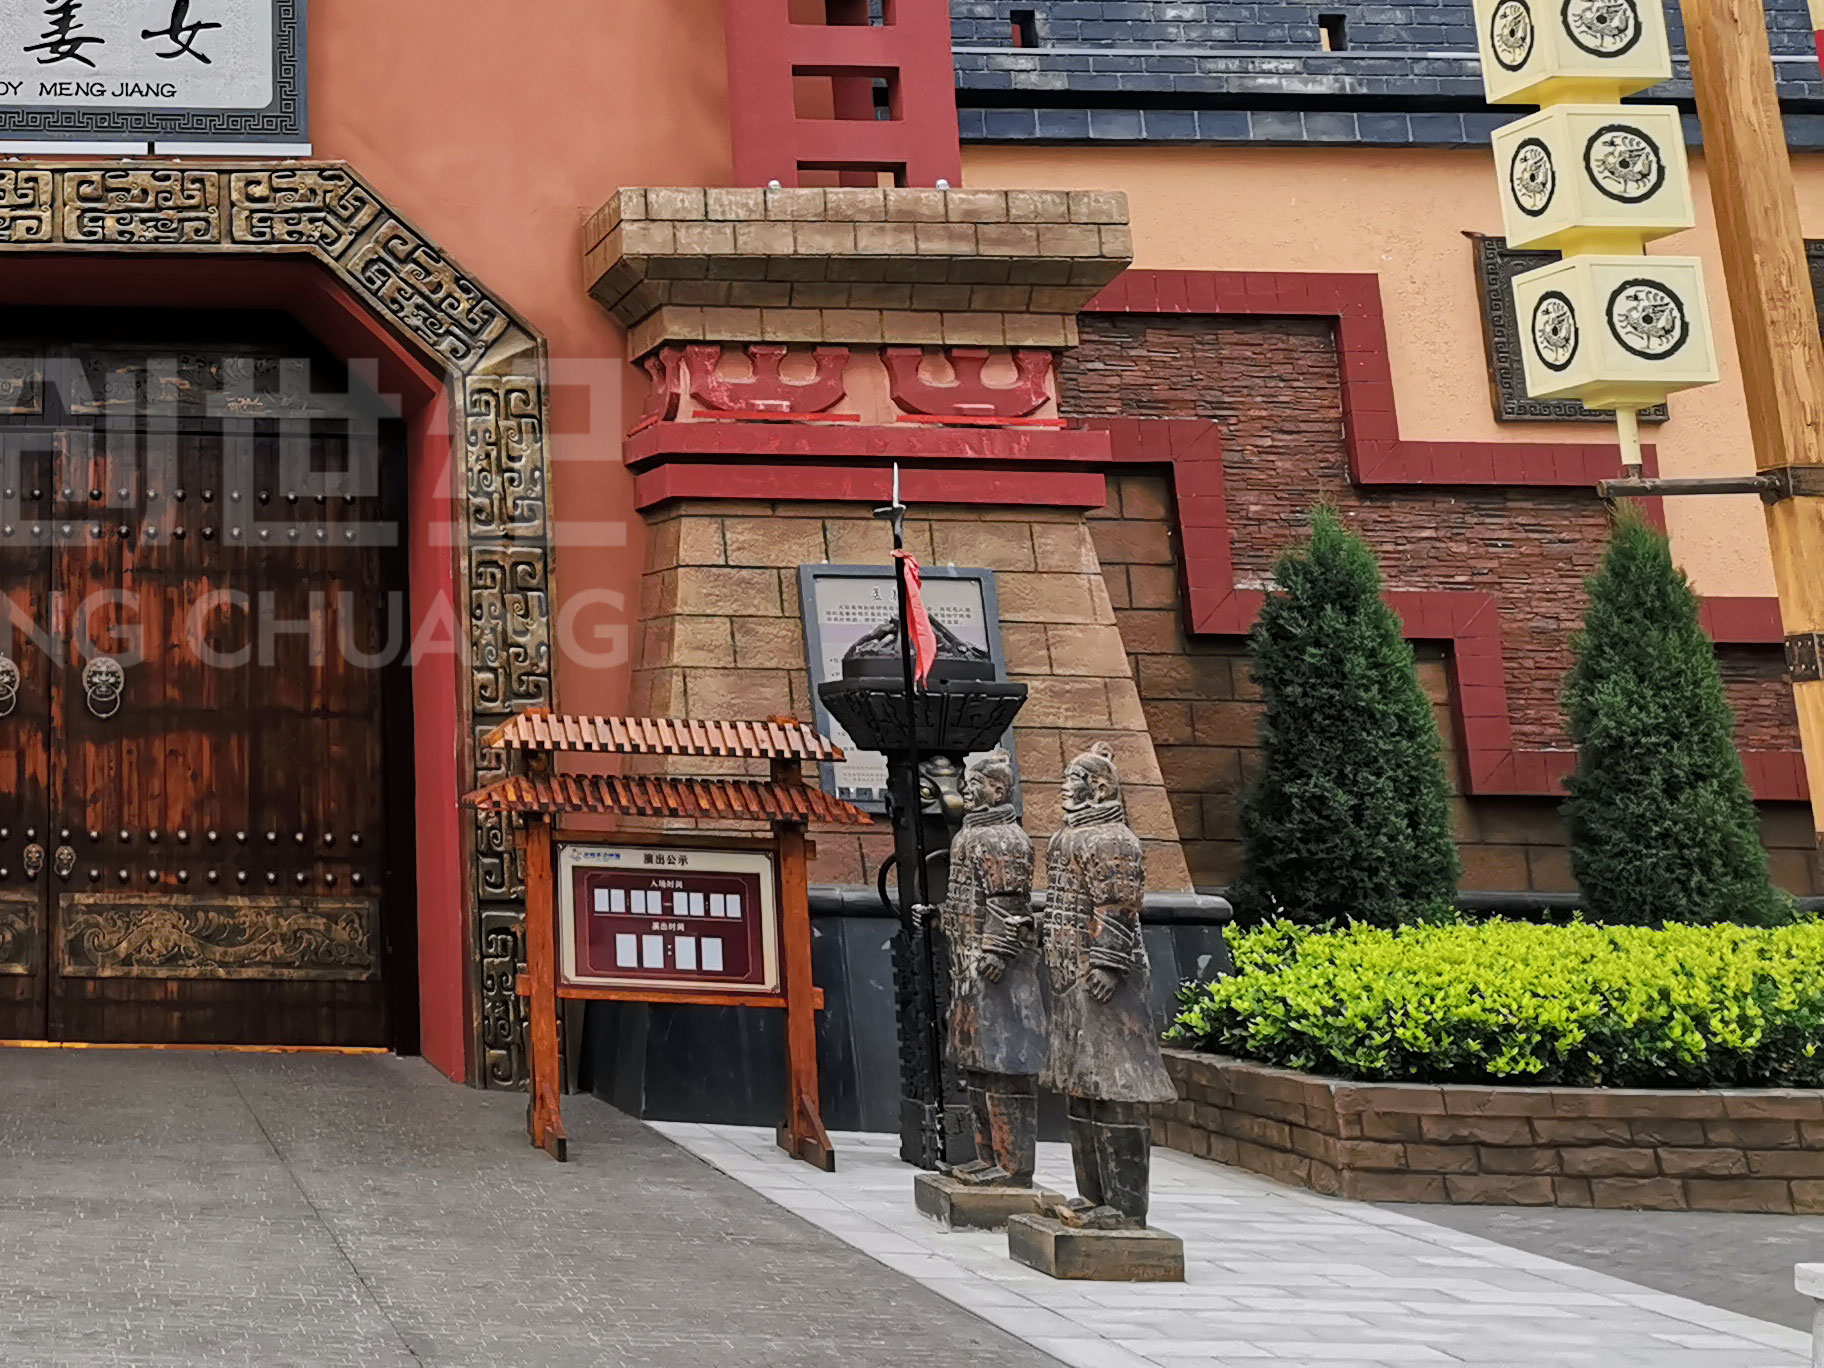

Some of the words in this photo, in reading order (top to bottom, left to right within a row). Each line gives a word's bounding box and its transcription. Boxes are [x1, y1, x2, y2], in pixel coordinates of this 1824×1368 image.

[38, 81, 107, 98] MENG
[111, 82, 178, 99] JIANG
[643, 853, 689, 866] 演出公示
[650, 879, 684, 889] 入场时间
[651, 921, 685, 932] 演出时间
